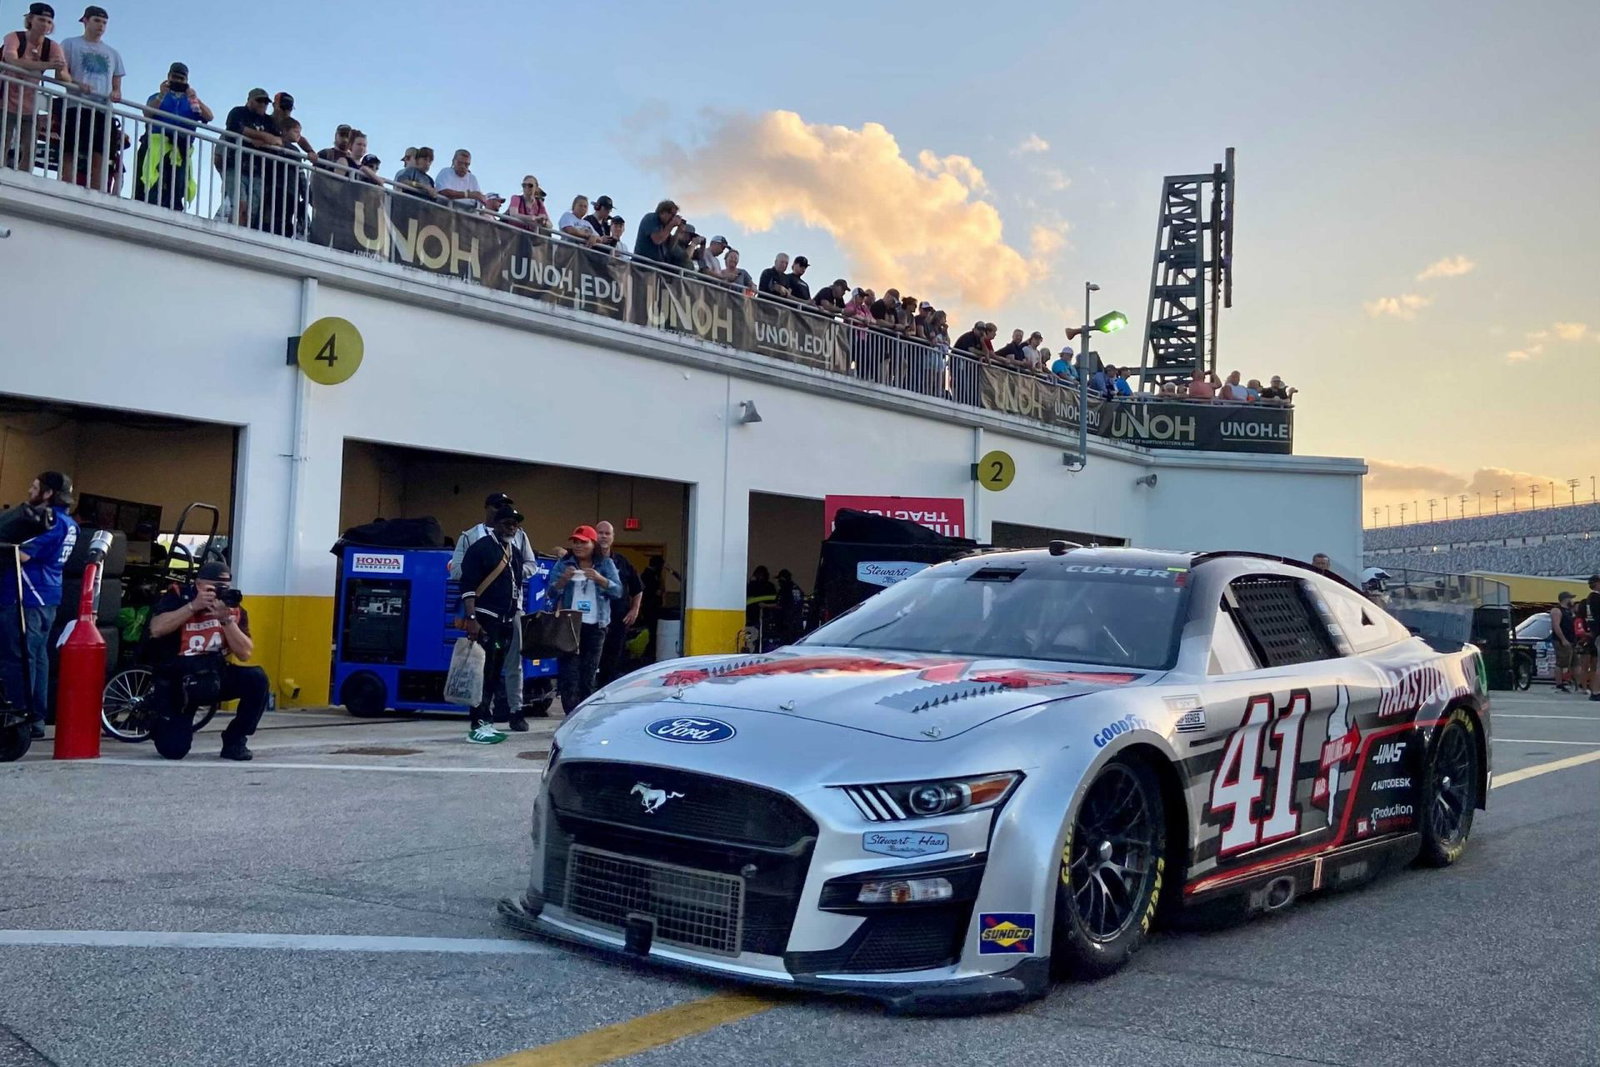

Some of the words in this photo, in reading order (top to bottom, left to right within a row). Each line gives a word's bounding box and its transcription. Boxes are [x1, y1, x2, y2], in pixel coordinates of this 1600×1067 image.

[354, 200, 481, 278] UNOH
[646, 278, 733, 343] UNOH
[314, 333, 338, 367] 4
[993, 374, 1043, 419] UNOH
[1054, 401, 1100, 427] UNOHDU
[1111, 404, 1196, 440] UNOH
[990, 461, 1003, 482] 2
[356, 557, 400, 565] HONDA
[861, 564, 909, 577] Stewart
[1066, 565, 1170, 578] CUSTER
[658, 719, 719, 739] Ford
[1210, 694, 1307, 856] 41
[1377, 778, 1411, 790] AUTODESK
[1375, 804, 1413, 819] Production
[983, 929, 1030, 940] SUNOCO
